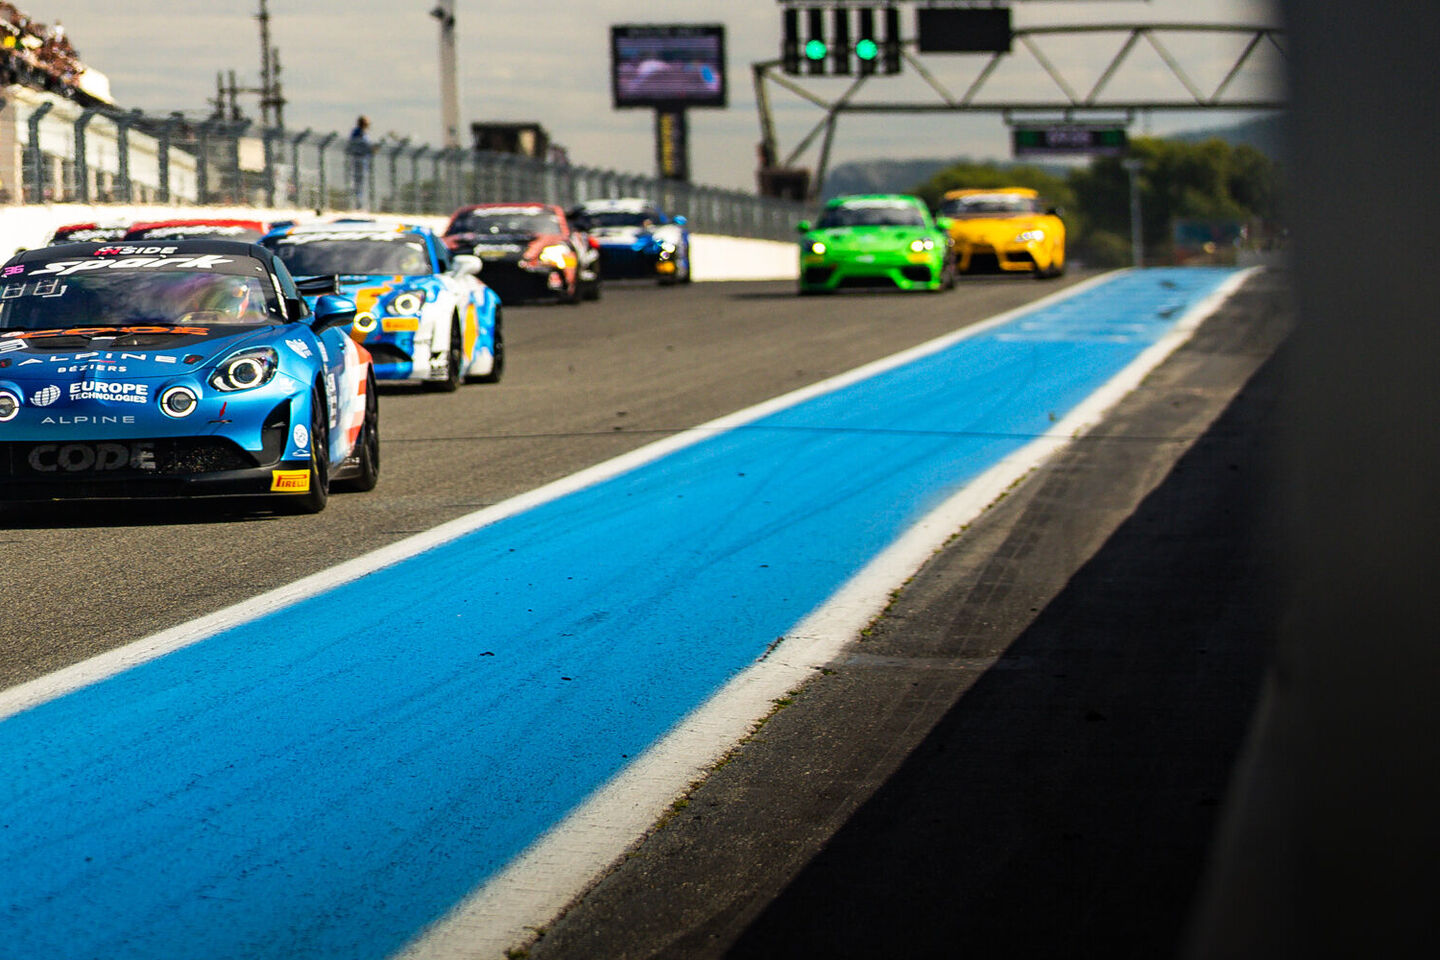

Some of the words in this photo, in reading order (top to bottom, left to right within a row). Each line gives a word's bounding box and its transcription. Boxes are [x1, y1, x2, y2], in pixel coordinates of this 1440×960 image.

[18, 352, 177, 366] ALPINE
[69, 381, 148, 396] EUROPE
[70, 392, 147, 404] TECHNOLOGIES
[41, 416, 135, 424] ALPINE
[28, 443, 156, 472] CODE
[276, 474, 307, 487] PIRELLI
